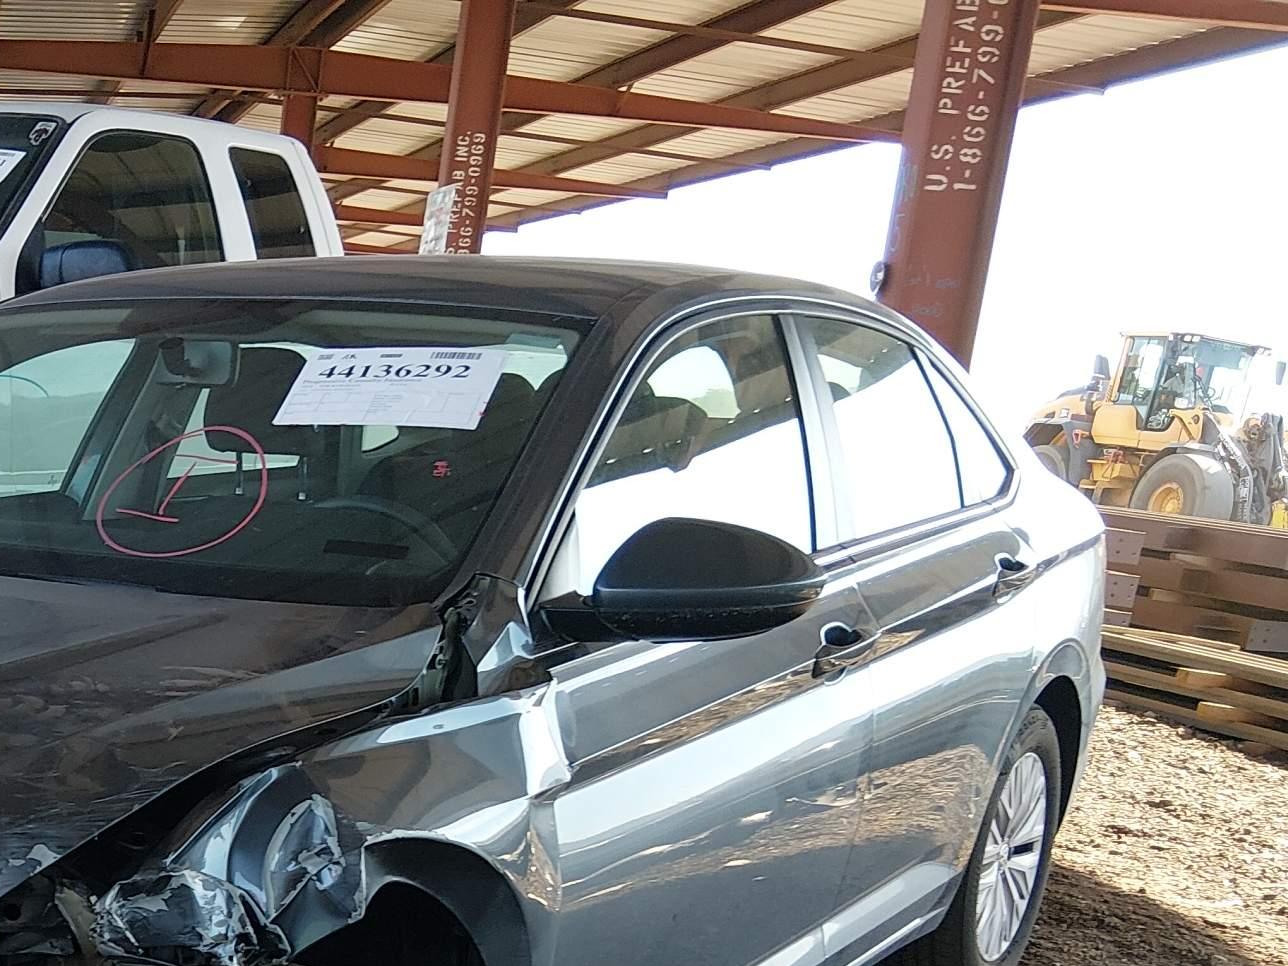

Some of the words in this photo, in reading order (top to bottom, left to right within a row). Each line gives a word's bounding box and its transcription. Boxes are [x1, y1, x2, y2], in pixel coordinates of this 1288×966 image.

[938, 0, 980, 115] PREFAB
[454, 130, 472, 161] INC.
[924, 135, 956, 191] U.S.
[318, 364, 471, 378] 44136292
